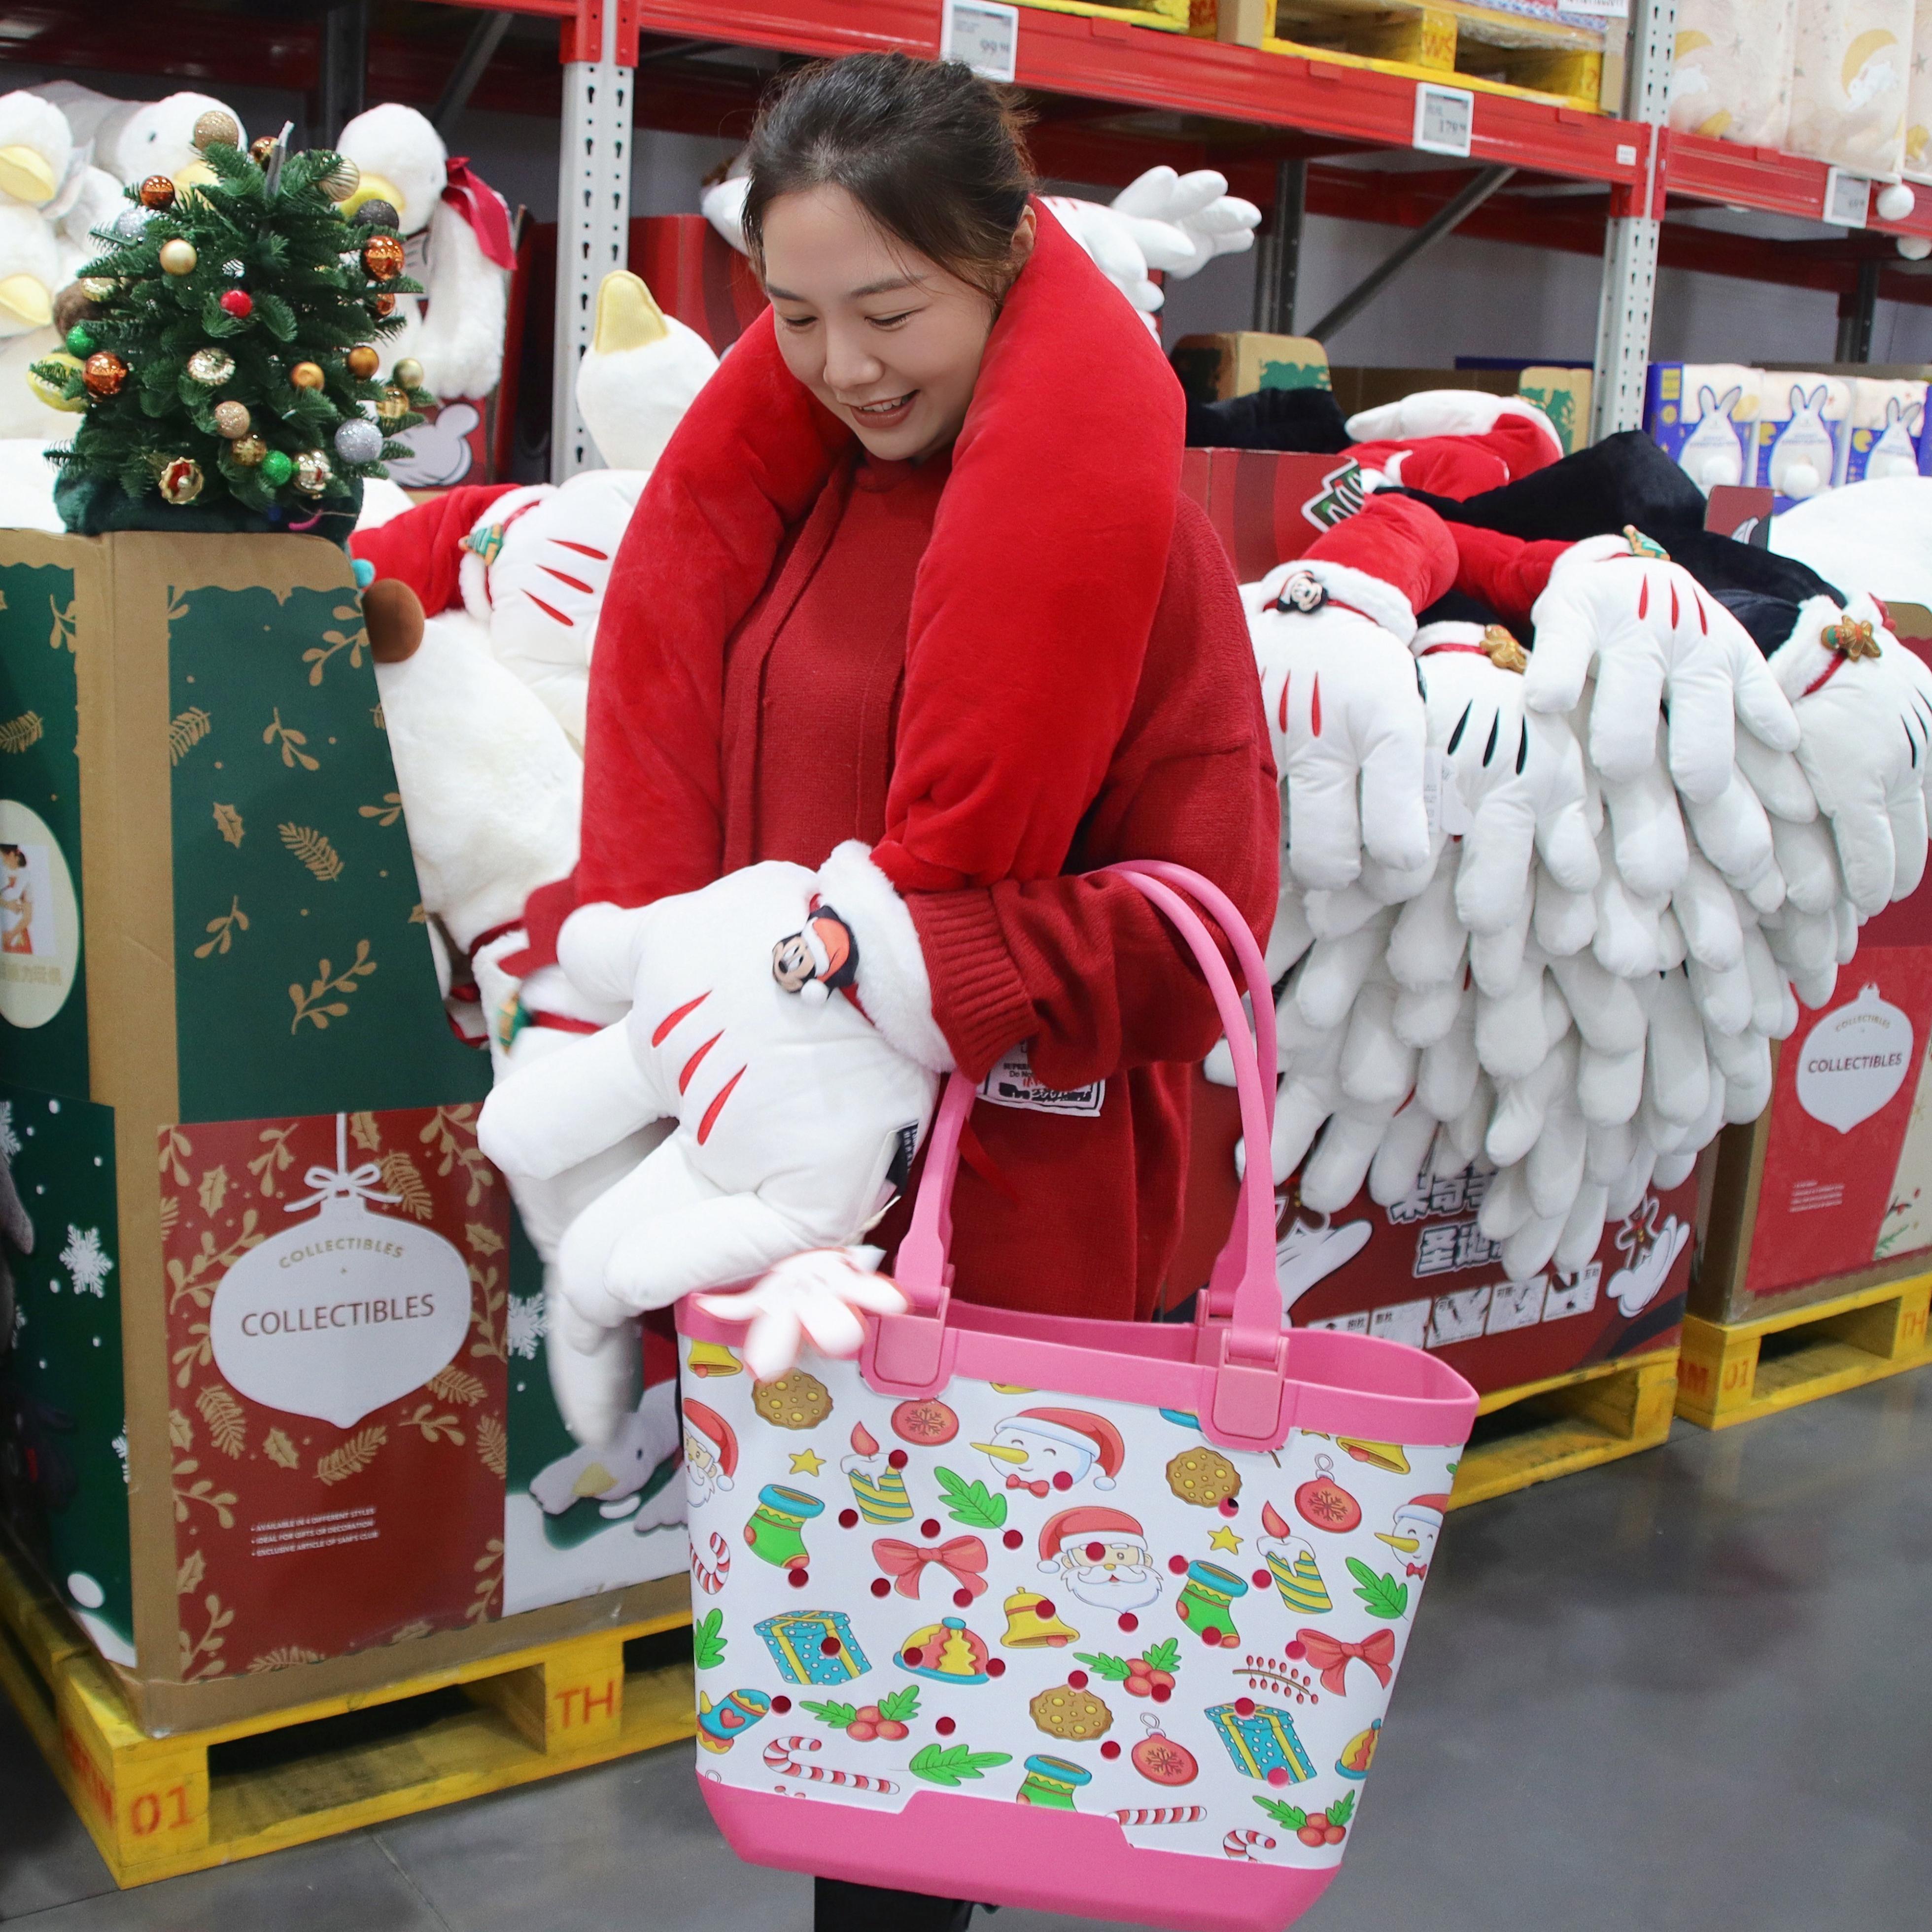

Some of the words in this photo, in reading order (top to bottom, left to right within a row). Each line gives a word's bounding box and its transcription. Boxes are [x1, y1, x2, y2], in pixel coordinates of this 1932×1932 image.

[1834, 1014, 1891, 1033] COLLECTIBLES
[1808, 1052, 1902, 1073] COLLECTIBLES
[278, 1238, 404, 1269] COLLECTIBLES
[241, 1294, 435, 1337] COLLECTIBLES
[554, 1680, 616, 1729] TH
[130, 1785, 195, 1838] 01
